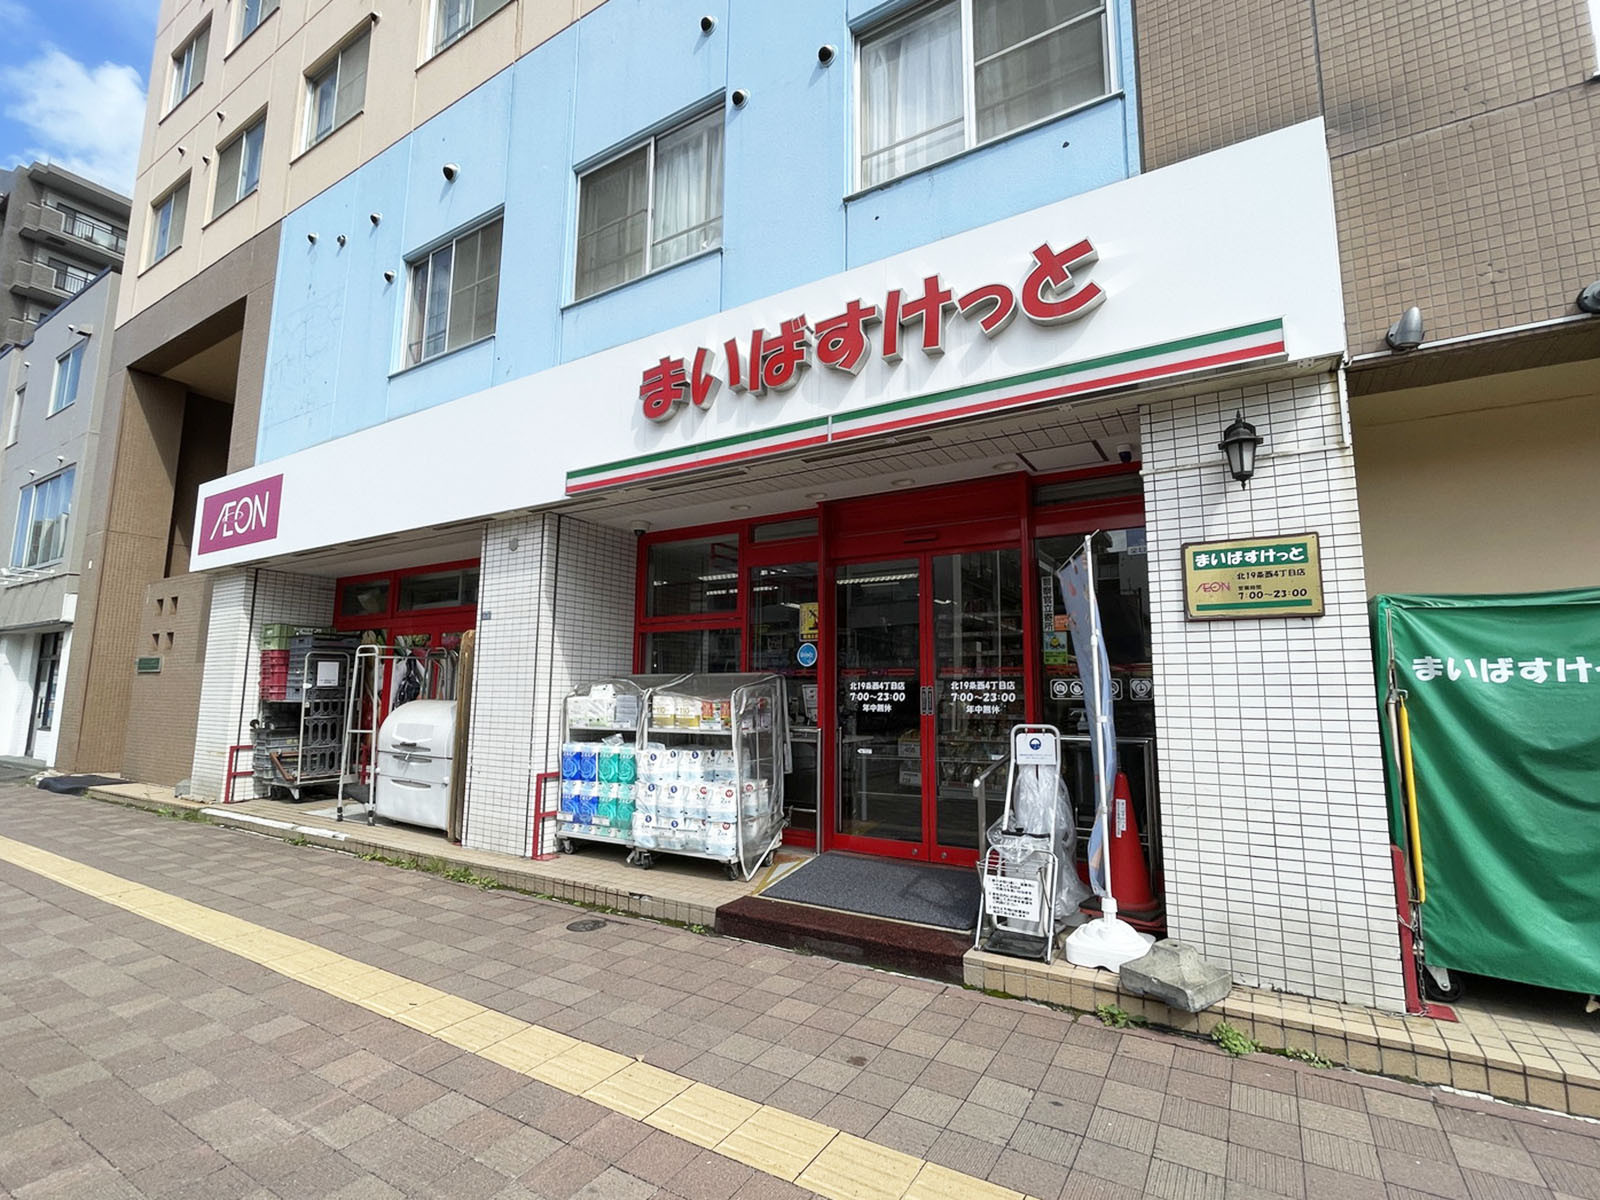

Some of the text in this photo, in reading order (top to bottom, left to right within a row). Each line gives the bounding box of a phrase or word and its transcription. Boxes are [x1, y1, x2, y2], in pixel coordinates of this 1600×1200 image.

[640, 237, 1106, 423] まいばすけっと
[1194, 546, 1305, 568] まいばすけっと
[1236, 568, 1306, 580] 北19条西4丁目店
[1412, 656, 1600, 684] まいばすけ
[850, 681, 906, 691] 北19条西4丁目店
[951, 680, 1016, 690] 北19条西4丁目店
[862, 703, 892, 713] 年中無休
[966, 704, 1000, 714] 年中無休
